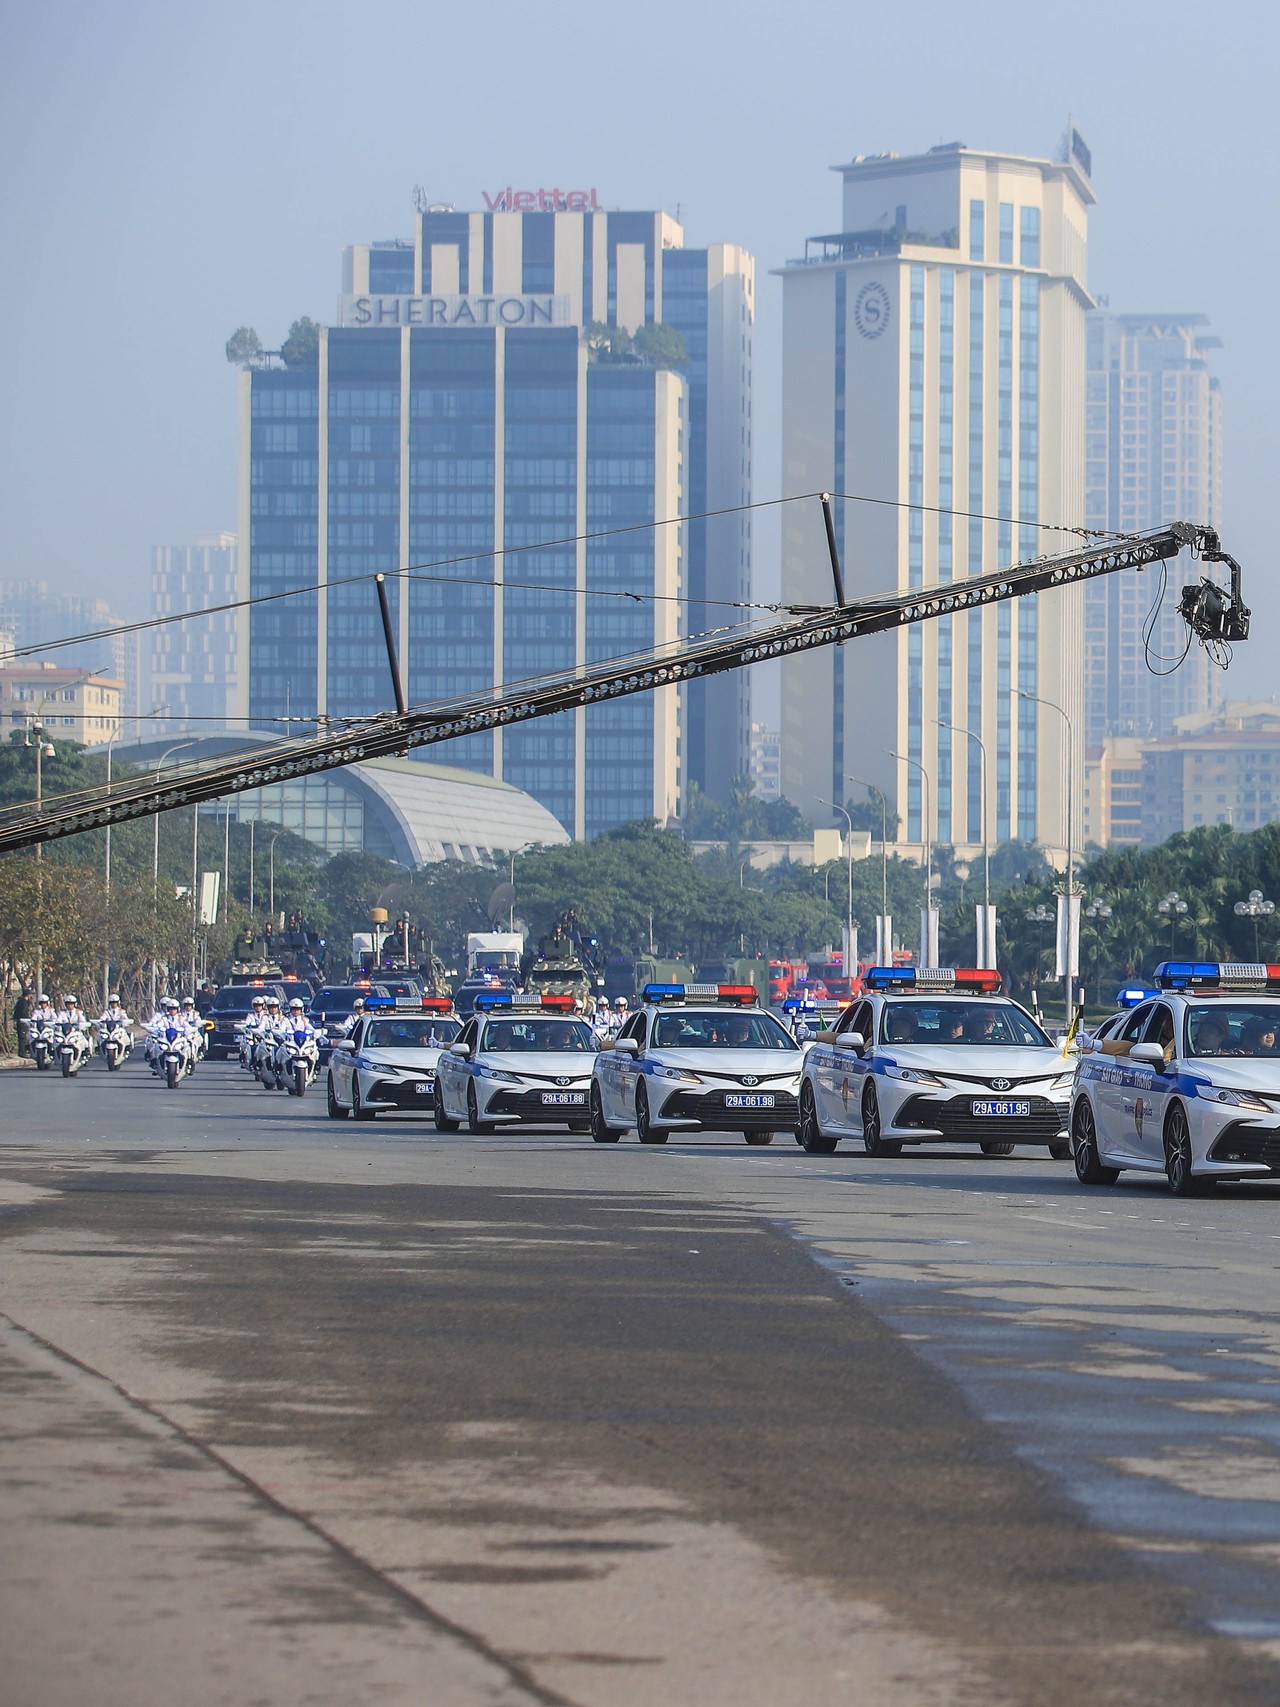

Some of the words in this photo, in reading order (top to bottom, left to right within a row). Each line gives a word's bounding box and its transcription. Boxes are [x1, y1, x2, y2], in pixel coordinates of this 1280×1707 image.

[482, 187, 604, 211] viettel
[354, 299, 553, 324] SHERATON
[865, 299, 880, 323] S
[727, 1096, 773, 1106] 29A-061.98
[975, 1103, 1028, 1114] 29A-061.95
